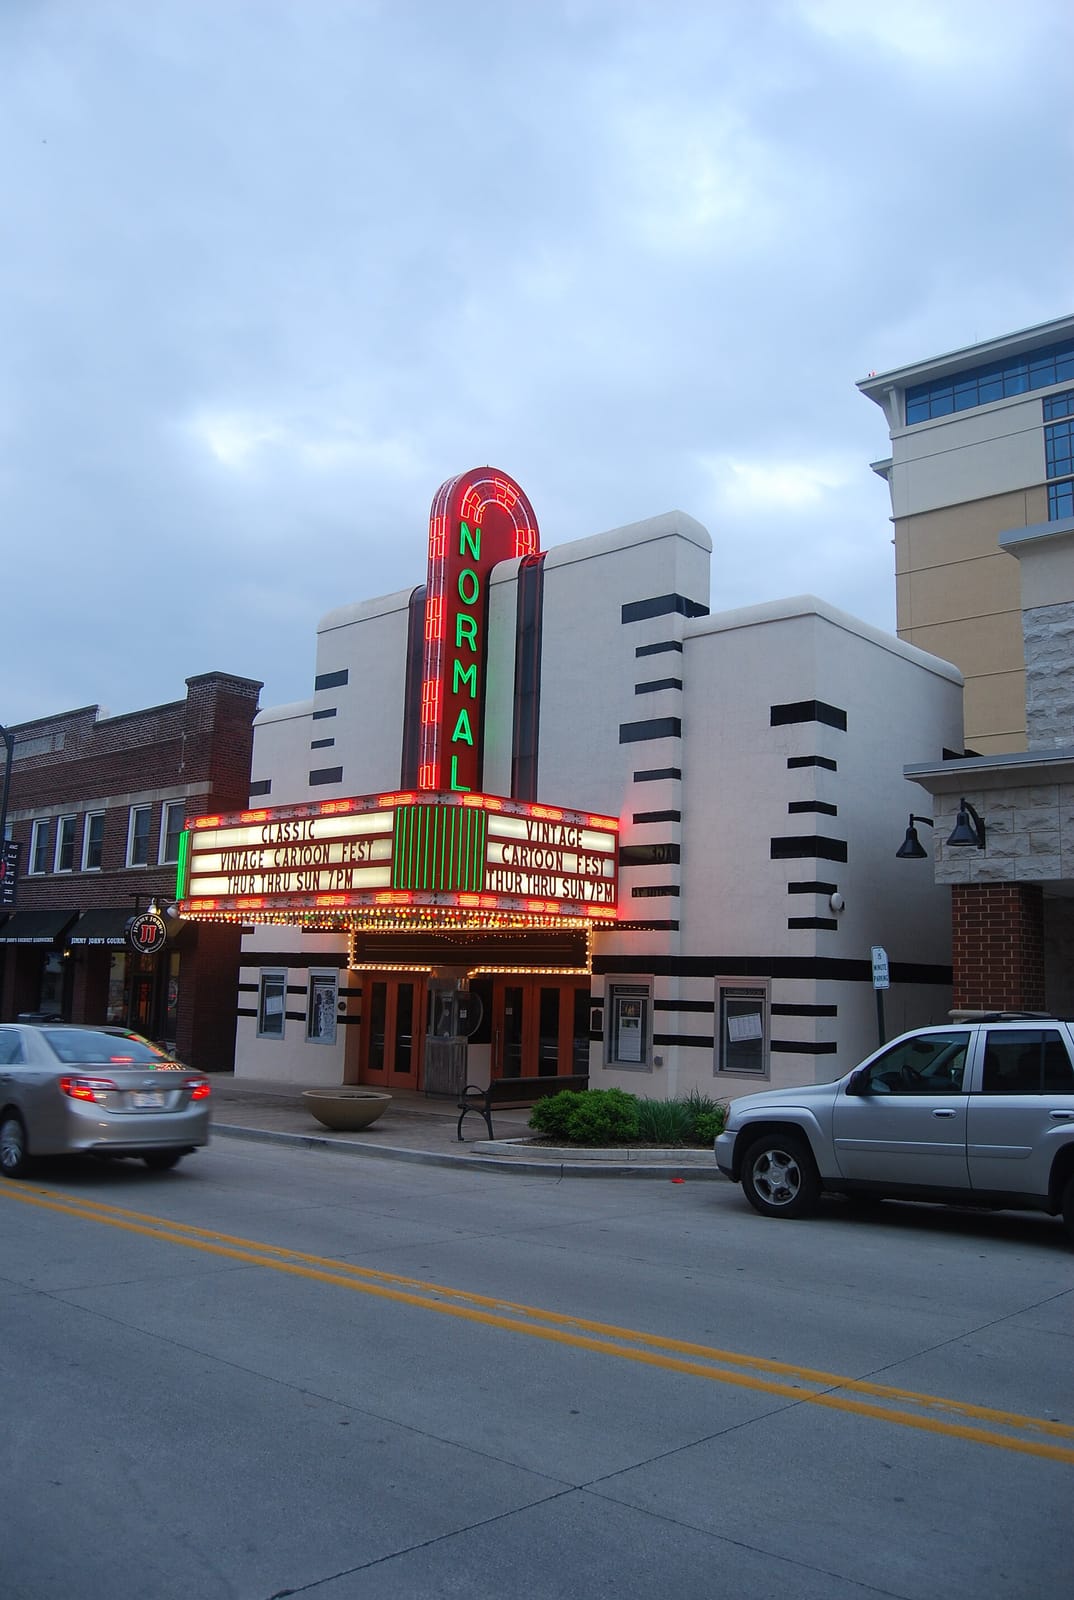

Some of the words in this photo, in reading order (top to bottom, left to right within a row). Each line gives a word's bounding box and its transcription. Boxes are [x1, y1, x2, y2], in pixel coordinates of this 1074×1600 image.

[451, 521, 481, 792] NORMAL
[261, 820, 315, 843] CLASSIC
[526, 820, 582, 848] VINTAGE
[220, 849, 264, 871] VINTAGE
[274, 843, 330, 868] CARTOON
[342, 841, 374, 862] FEST
[502, 844, 563, 871] CARTOON
[576, 855, 605, 877] FEST
[3, 844, 18, 904] THEATER
[227, 875, 255, 895] THUR
[261, 873, 290, 892] THRU
[296, 871, 320, 890] SUN
[486, 871, 522, 894] THUR
[526, 874, 557, 896] THRU
[562, 879, 585, 899] SUN
[133, 916, 148, 933] JIMMY
[140, 924, 157, 943] JJ
